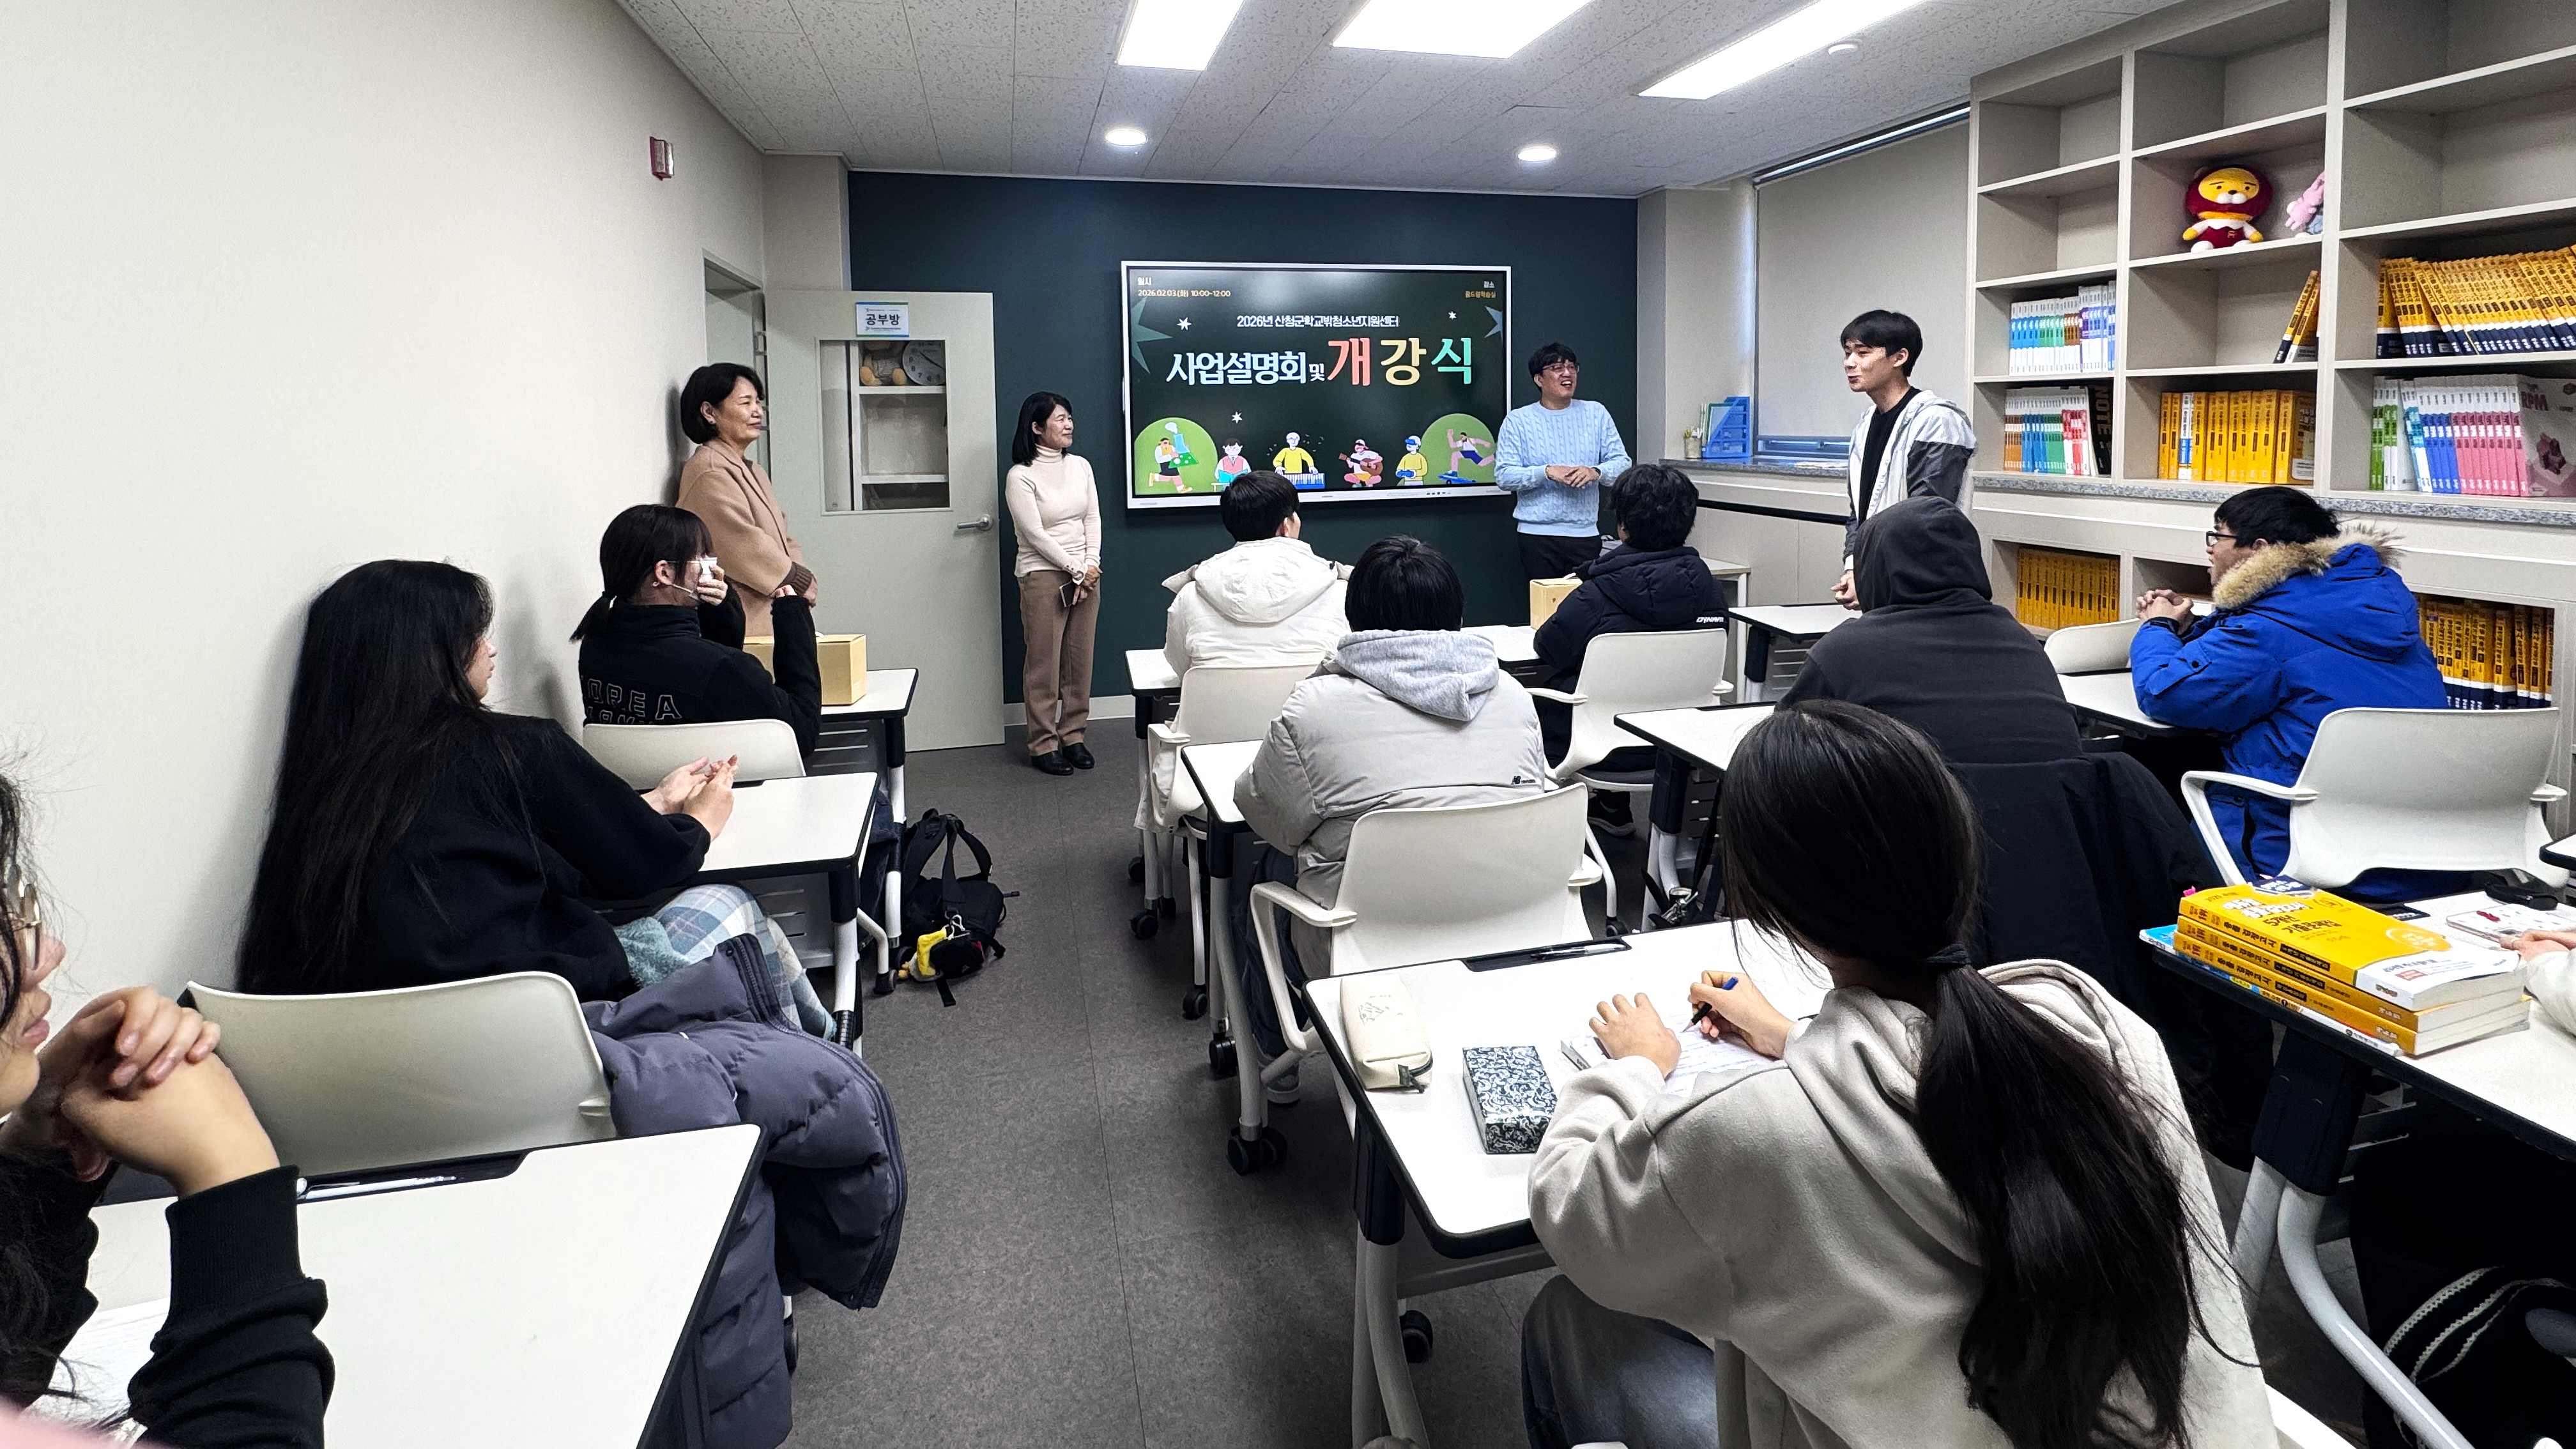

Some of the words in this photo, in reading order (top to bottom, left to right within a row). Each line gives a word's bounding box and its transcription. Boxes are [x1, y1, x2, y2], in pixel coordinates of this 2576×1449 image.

[1137, 277, 1152, 286] 일시
[865, 314, 900, 325] 공부방
[1237, 315, 1273, 328] 2026년
[1166, 351, 1307, 385] 사업설명회
[1308, 363, 1325, 381] 및
[581, 675, 682, 720] OREA
